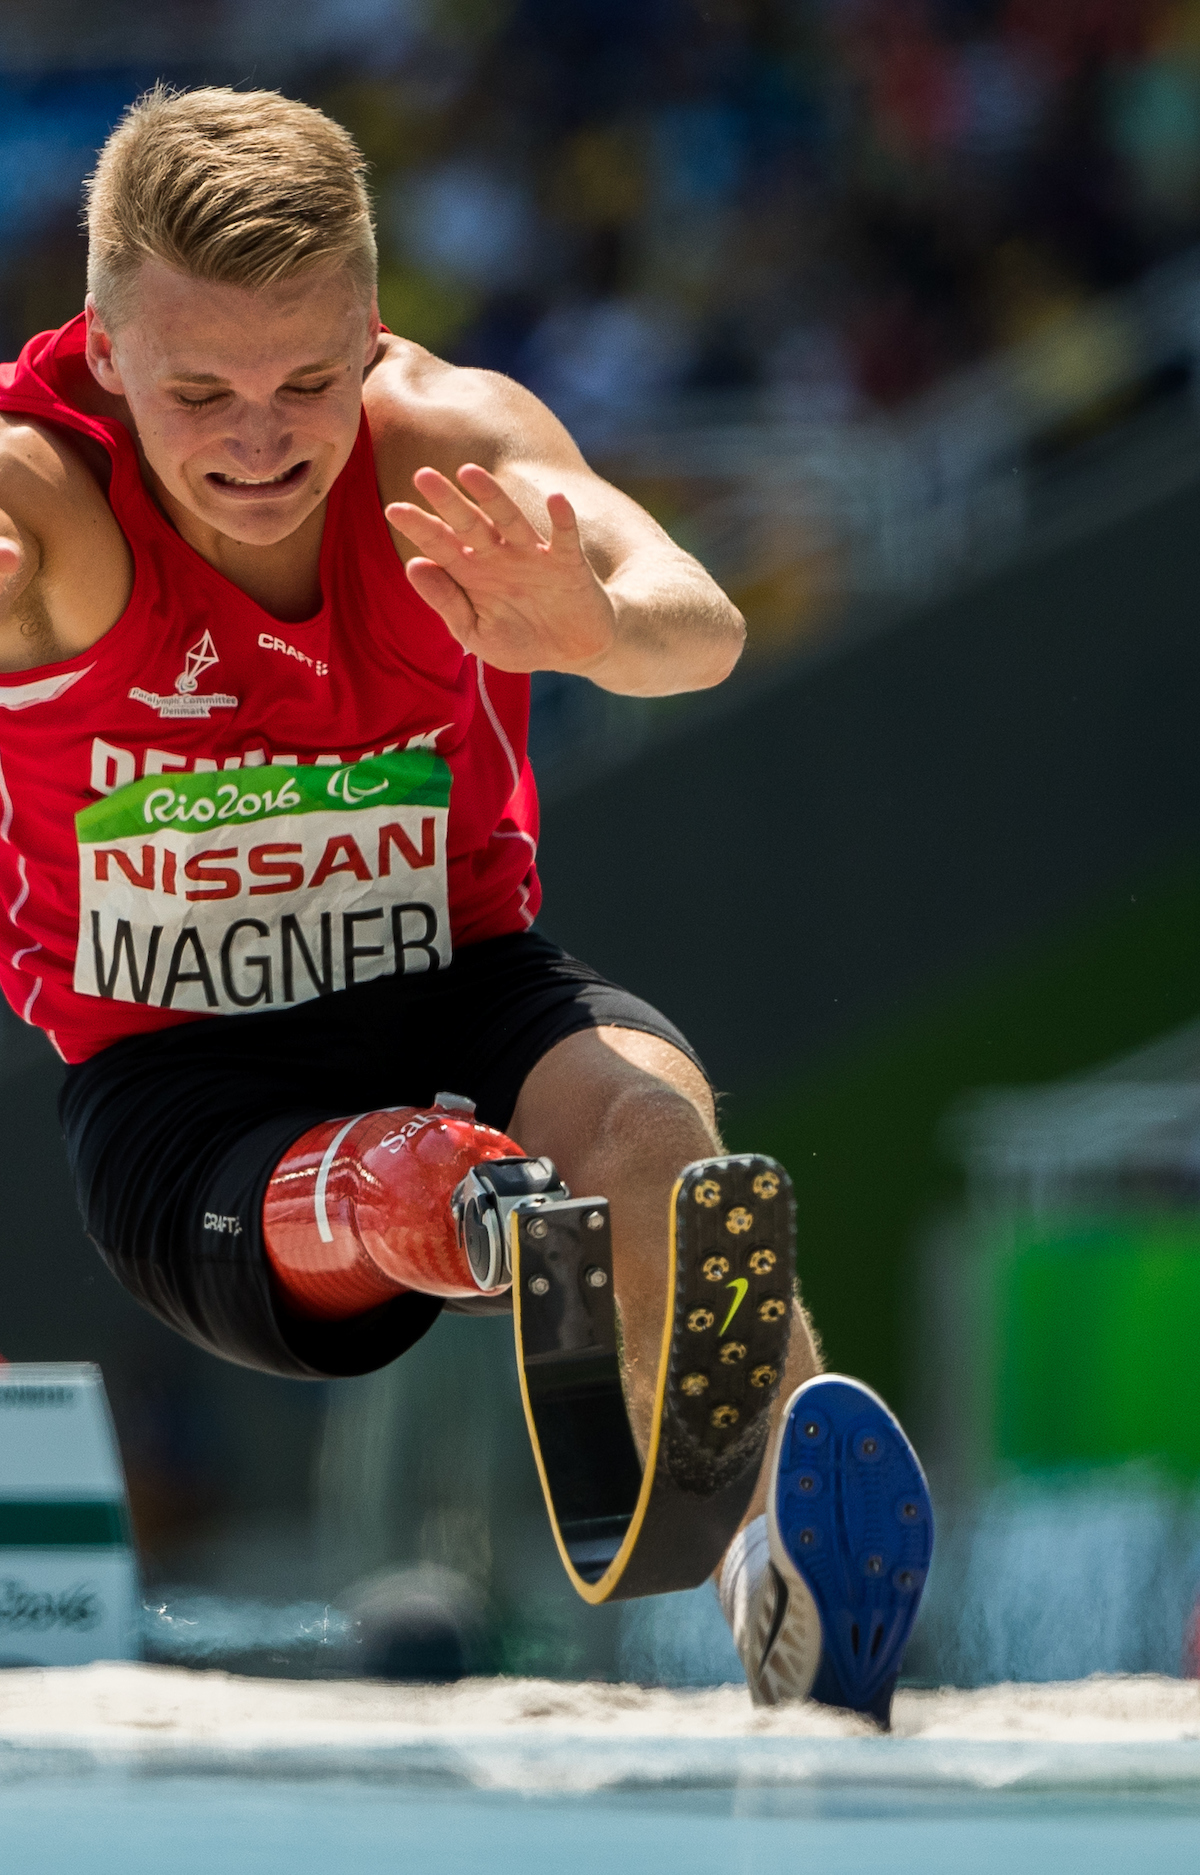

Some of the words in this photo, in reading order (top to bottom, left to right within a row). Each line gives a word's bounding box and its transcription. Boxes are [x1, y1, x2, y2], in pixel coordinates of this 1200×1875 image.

[258, 633, 313, 668] CRAFT
[161, 706, 208, 716] Denmark
[183, 694, 238, 705] Committee
[143, 778, 301, 824] Rio2016
[93, 817, 437, 902] NISSAN
[89, 901, 441, 1009] WAGNER
[204, 1212, 236, 1234] CRAFT
